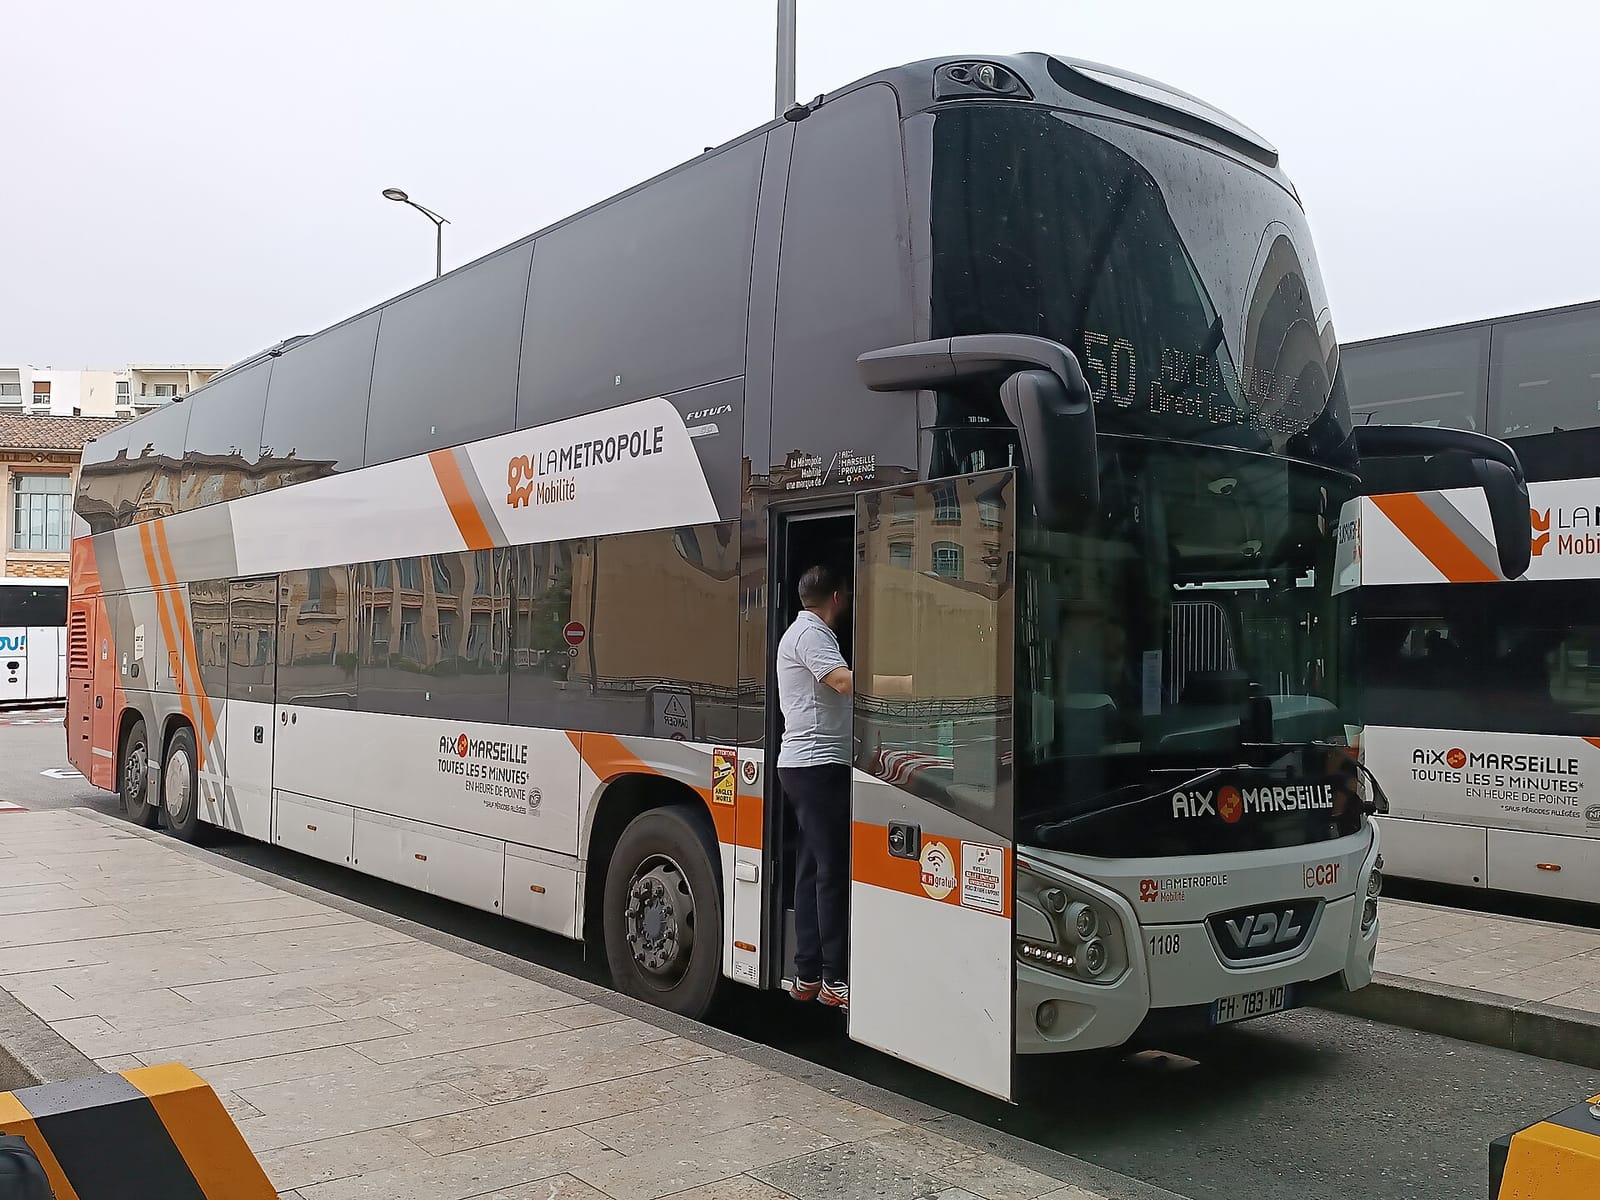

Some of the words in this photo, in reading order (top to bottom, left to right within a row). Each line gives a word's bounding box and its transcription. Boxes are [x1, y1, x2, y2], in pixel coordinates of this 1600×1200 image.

[1084, 330, 1136, 408] 50
[1150, 380, 1203, 417] Direct
[686, 404, 732, 420] FUTURA
[538, 426, 664, 476] LAMETROPOLE
[841, 464, 876, 476] PROVENCE
[536, 476, 576, 505] Mobilité
[1559, 506, 1600, 528] LA
[438, 759, 464, 775] TOUTES
[466, 764, 480, 778] LES
[481, 766, 487, 779] 5
[1411, 768, 1461, 783] TOUTES
[1466, 773, 1491, 786] LES
[1495, 776, 1505, 787] 5
[465, 780, 475, 791] EN
[475, 782, 494, 795] HEURE
[495, 785, 503, 797] DE
[715, 788, 733, 796] ANGLES
[1466, 787, 1481, 797] EN
[1484, 789, 1519, 801] HEURE
[1522, 792, 1536, 803] DE
[1161, 875, 1227, 890] LAMETROPOLE
[1225, 909, 1302, 948] VDL
[1150, 934, 1180, 955] 1108
